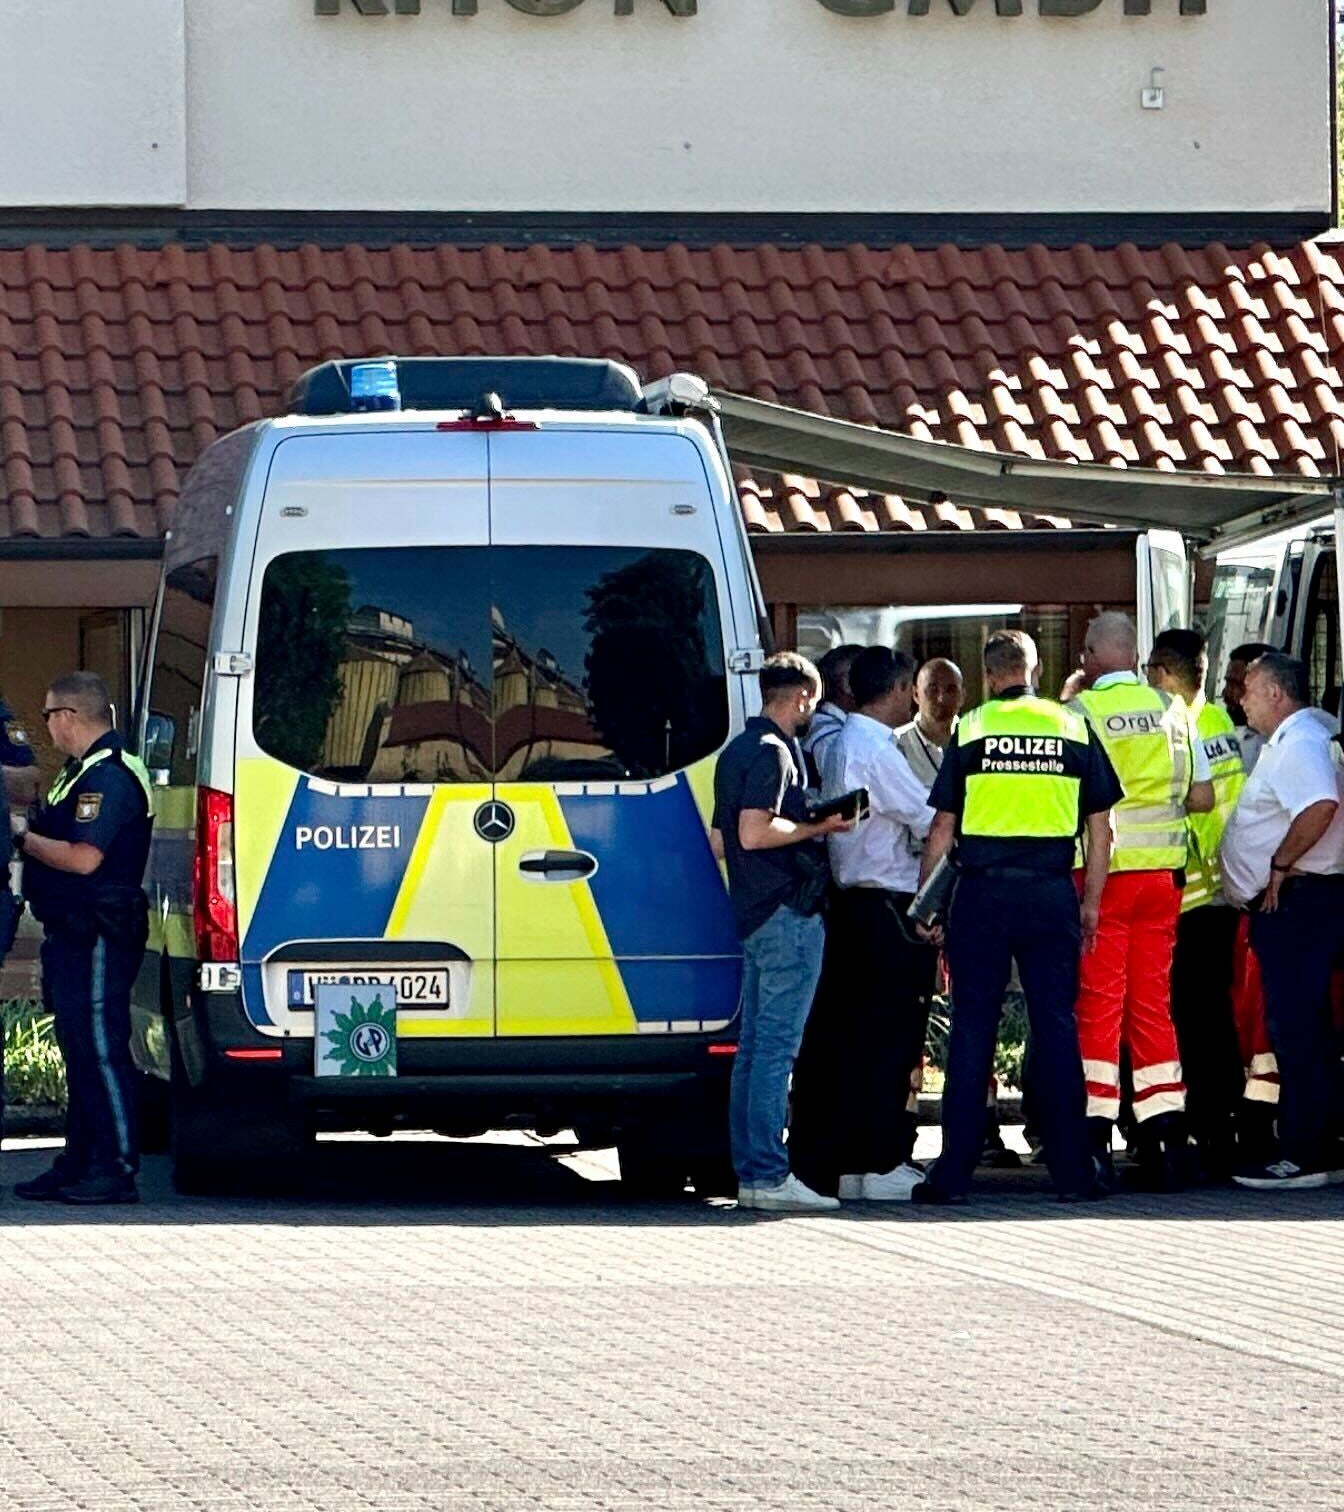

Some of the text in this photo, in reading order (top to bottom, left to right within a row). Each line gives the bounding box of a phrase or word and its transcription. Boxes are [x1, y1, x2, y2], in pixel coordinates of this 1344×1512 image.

[984, 736, 1063, 757] POLIZEI
[981, 758, 1065, 774] Pressestelle
[296, 825, 400, 850] POLIZEI
